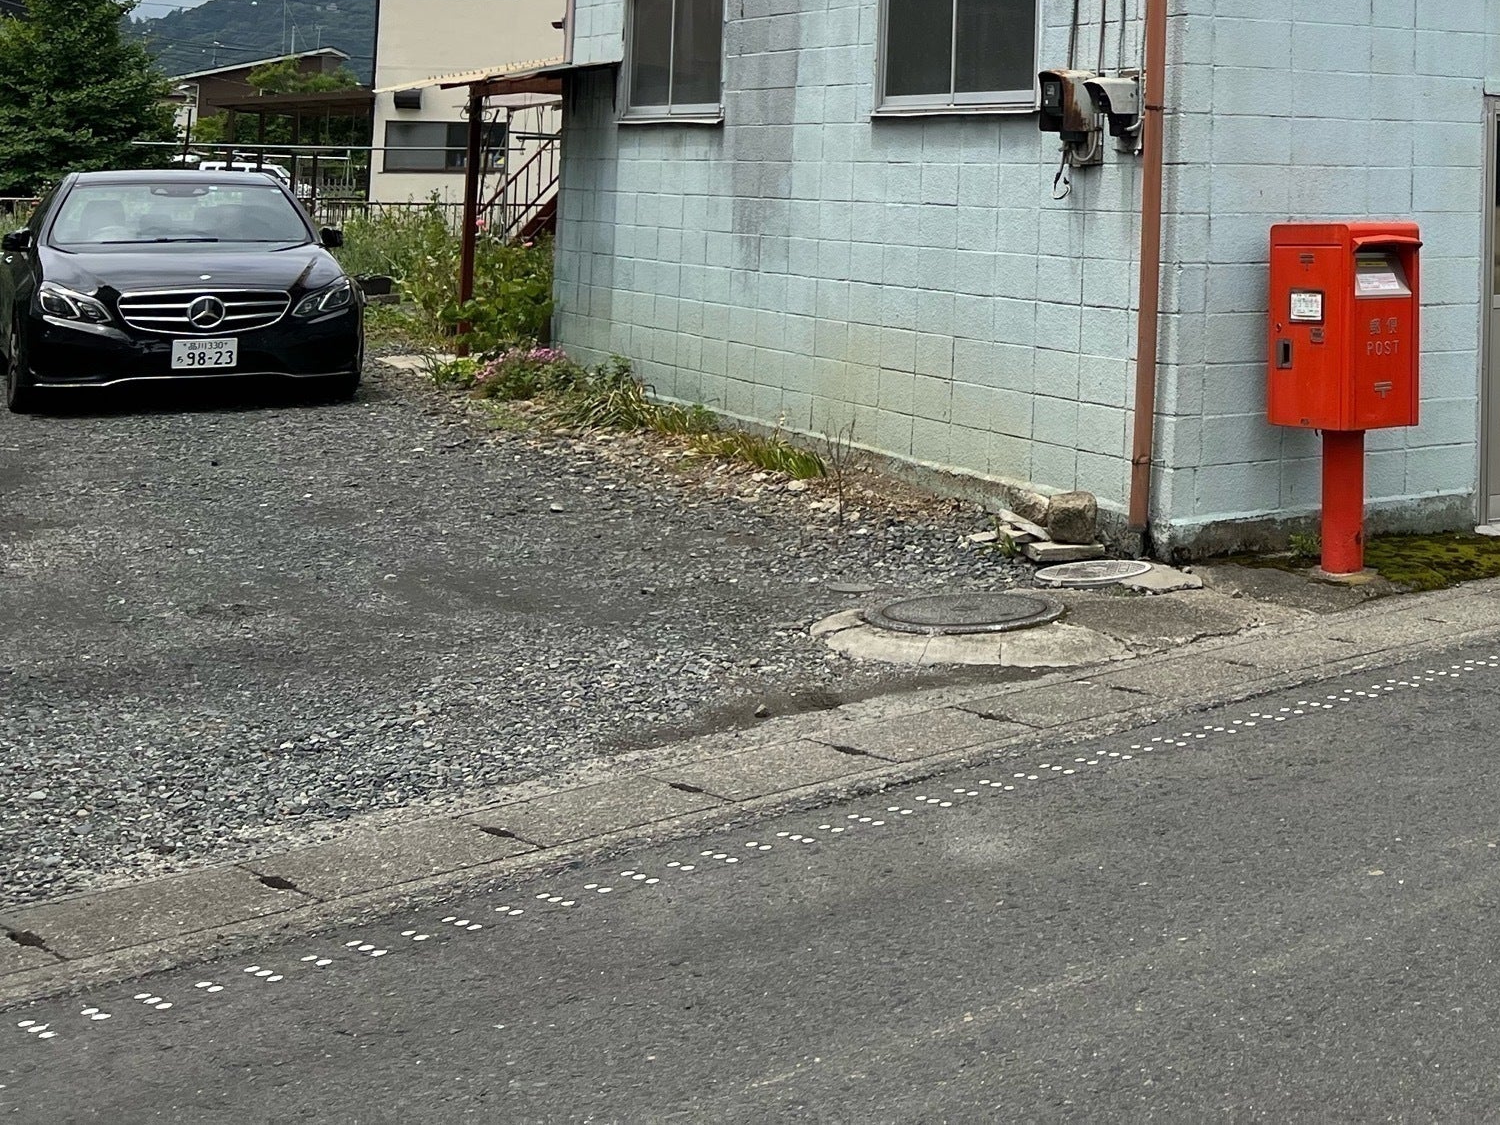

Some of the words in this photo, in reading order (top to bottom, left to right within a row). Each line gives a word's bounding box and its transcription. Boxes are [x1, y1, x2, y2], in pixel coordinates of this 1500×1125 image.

[1369, 317, 1398, 335] 郵便
[1367, 340, 1400, 356] POST
[186, 350, 234, 366] 98-23
